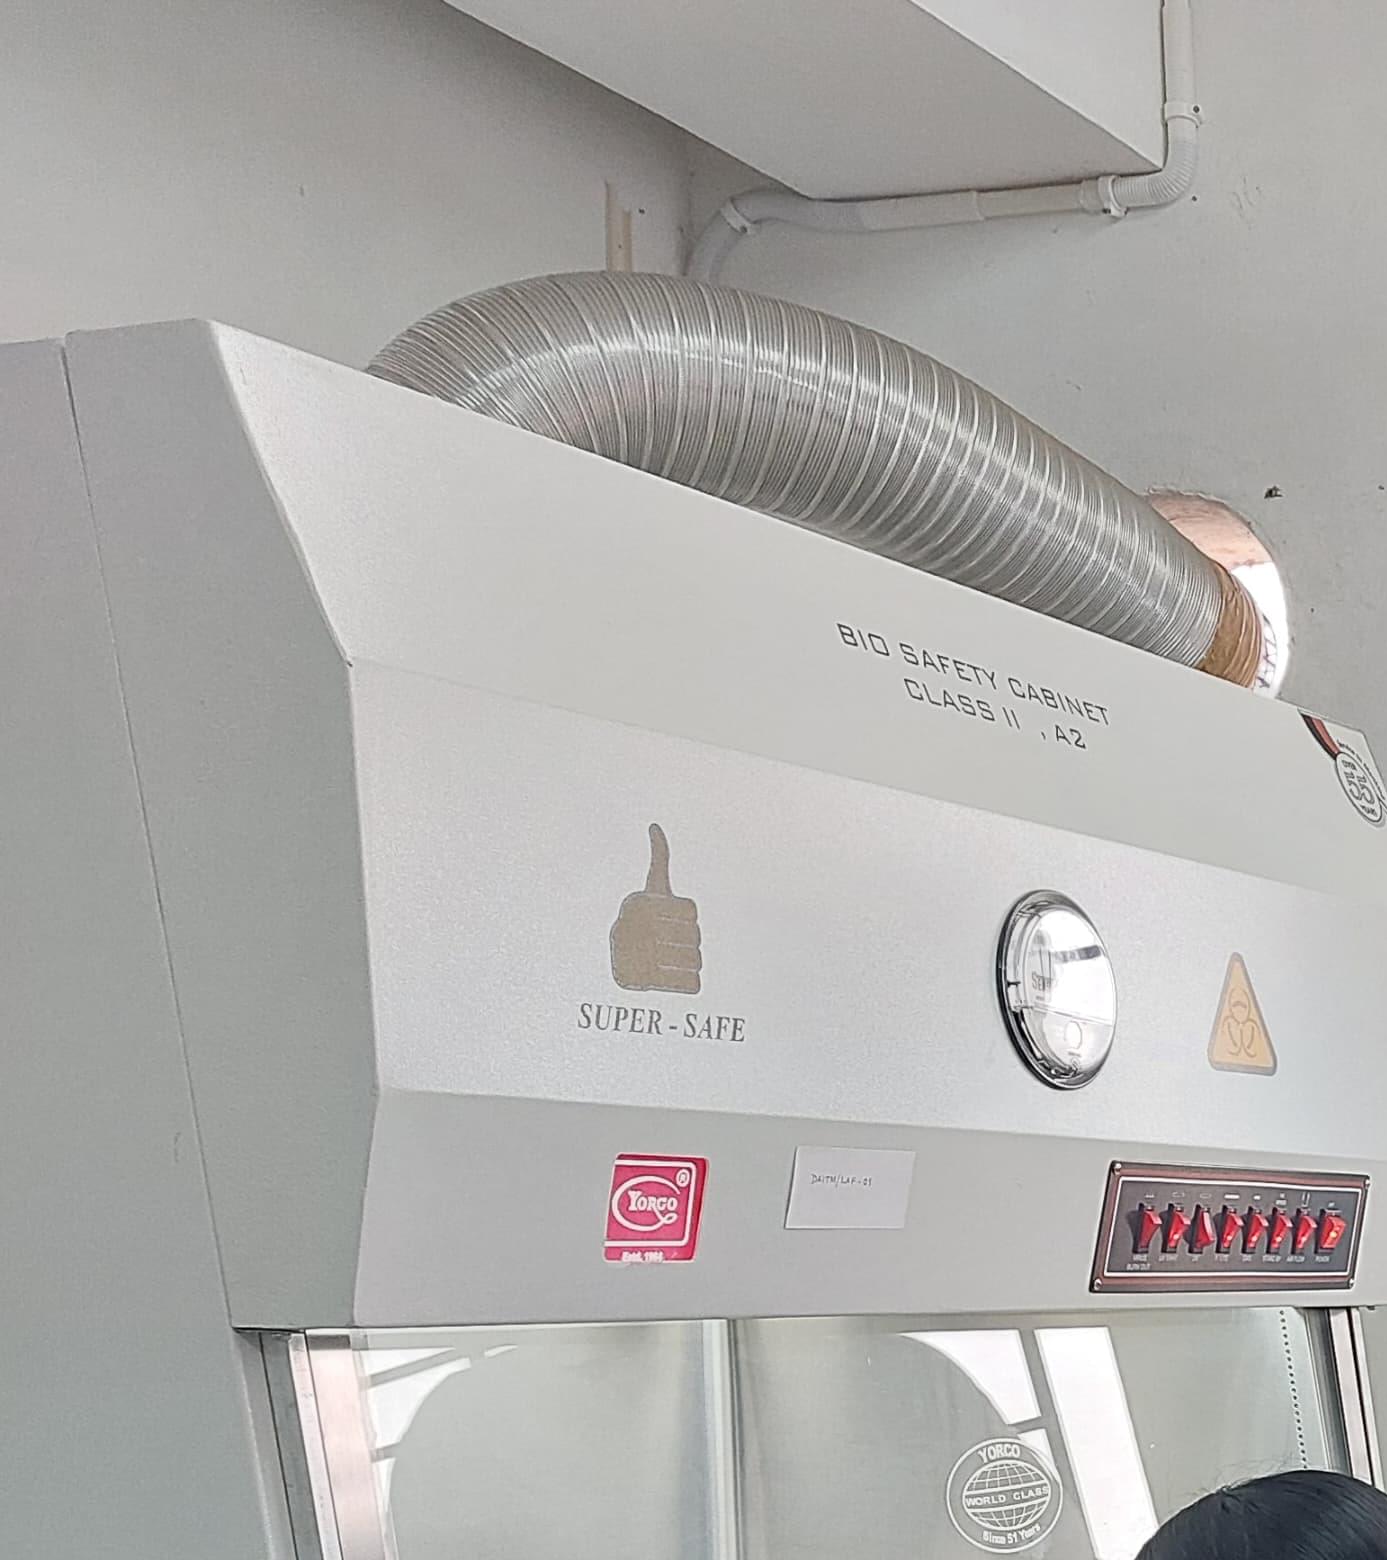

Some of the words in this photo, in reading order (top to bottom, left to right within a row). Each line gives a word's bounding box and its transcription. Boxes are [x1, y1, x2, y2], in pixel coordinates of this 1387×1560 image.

[836, 622, 890, 657] BIO
[898, 641, 998, 691] SAFETY
[1007, 676, 1110, 727] CABINET
[903, 677, 997, 722] CLASS
[576, 1001, 664, 1036] SUPER
[683, 1012, 746, 1043] SAFE
[977, 1443, 1021, 1465] YORCO
[965, 1494, 1007, 1508] WORLD
